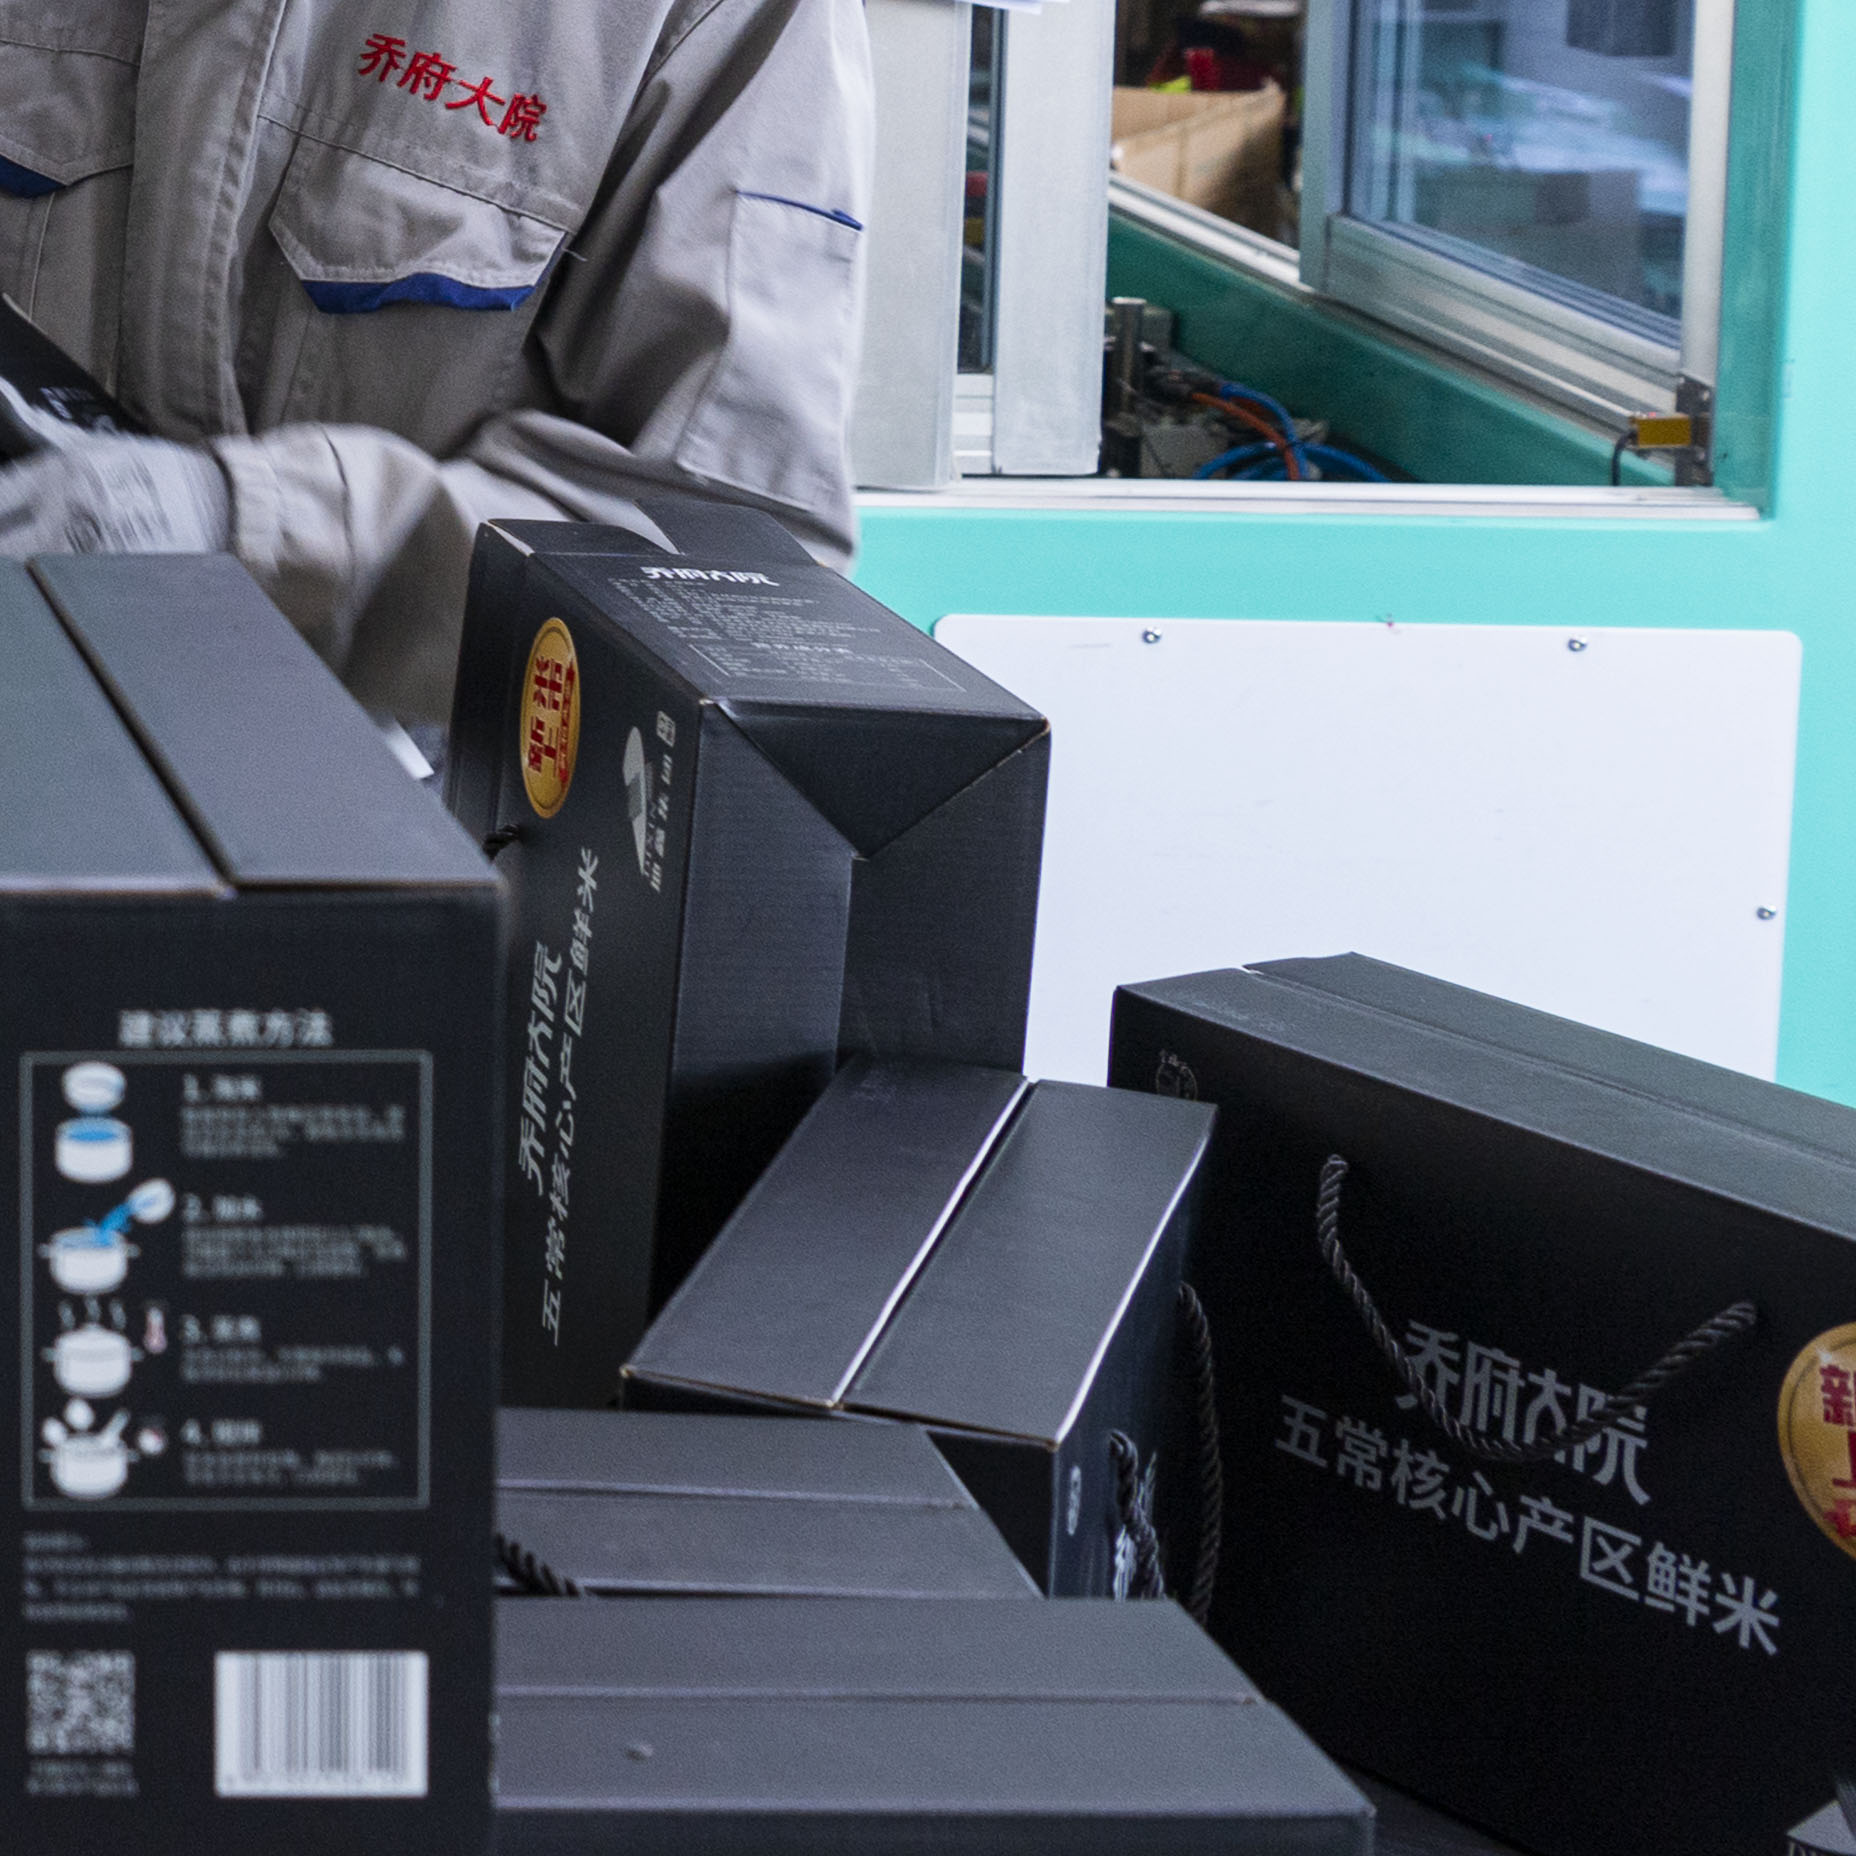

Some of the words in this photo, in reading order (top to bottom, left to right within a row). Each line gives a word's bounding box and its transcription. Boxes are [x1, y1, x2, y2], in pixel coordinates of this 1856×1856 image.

[358, 33, 548, 142] 乔府大院
[518, 940, 562, 1197] 乔府大院
[541, 846, 599, 1347] 五常核心产区鲜米
[1273, 1393, 1781, 1657] 五常核心产区鲜米
[1394, 1318, 1651, 1506] 乔府大院
